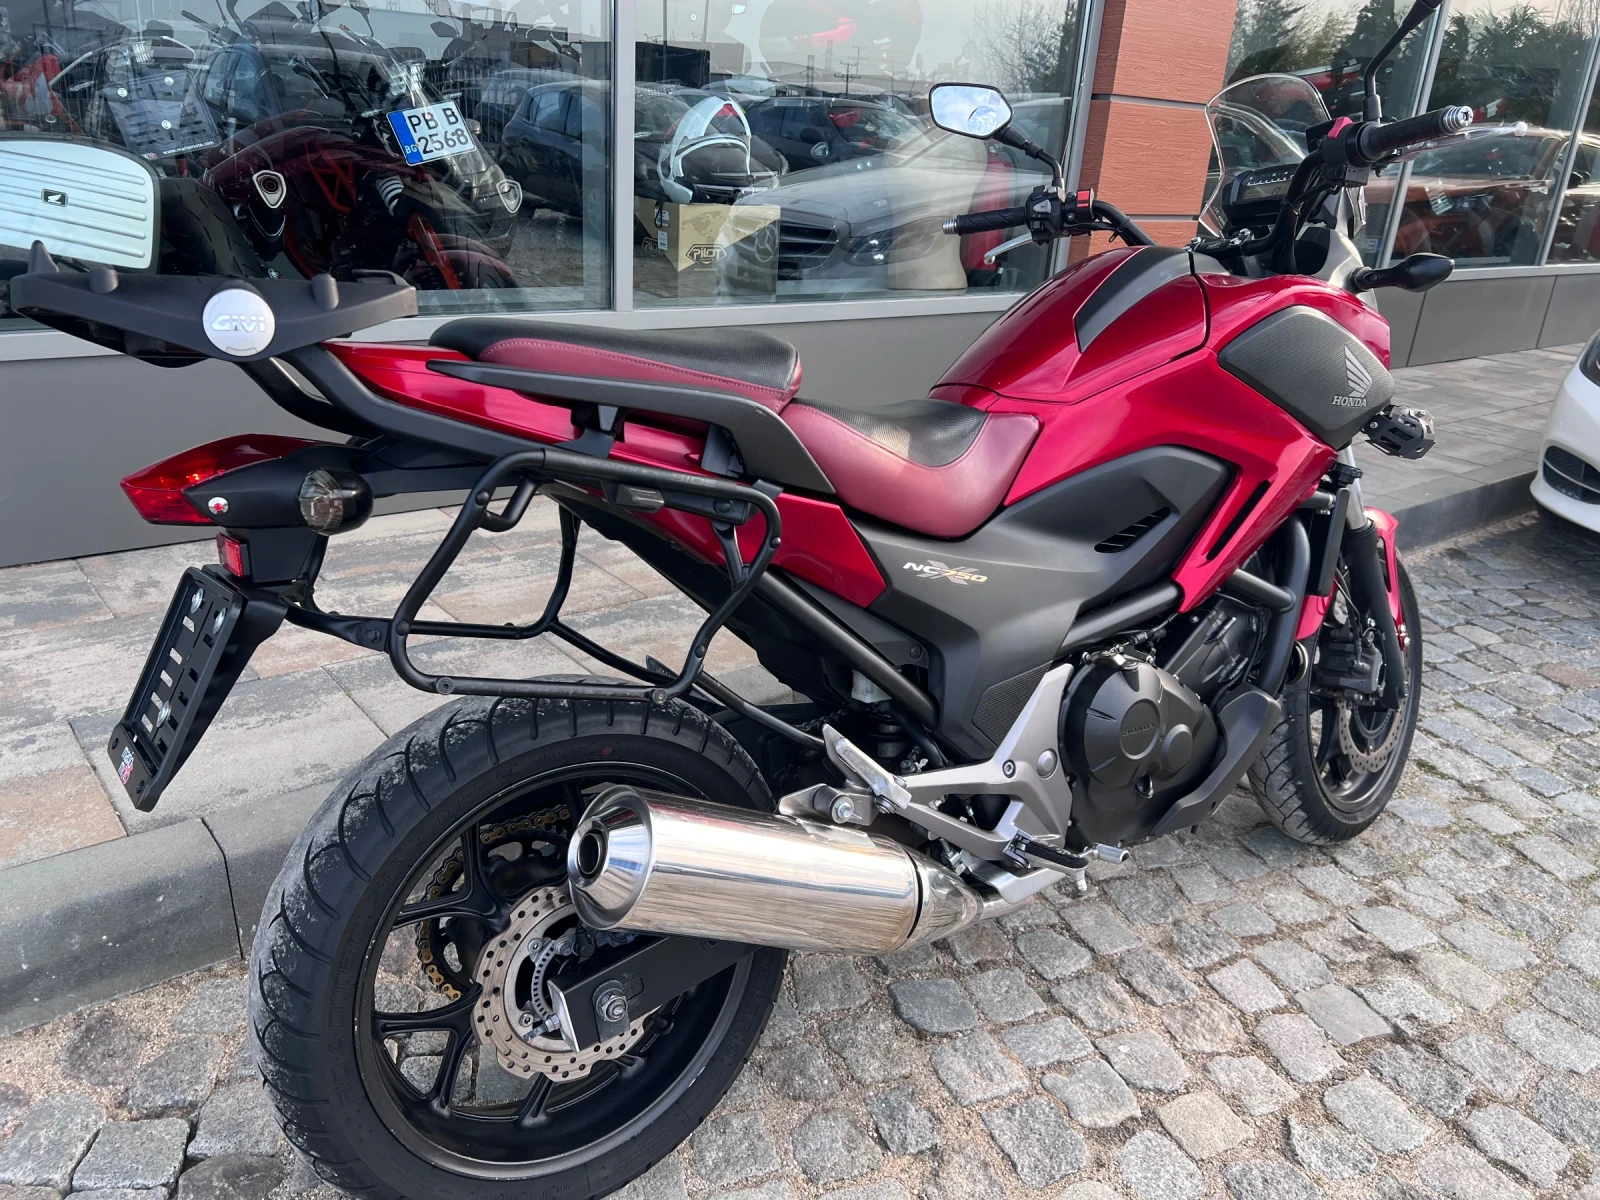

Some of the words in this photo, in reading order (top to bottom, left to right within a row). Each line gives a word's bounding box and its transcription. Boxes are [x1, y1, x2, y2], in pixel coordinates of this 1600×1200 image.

[407, 111, 439, 133] PB
[442, 107, 459, 126] B
[405, 145, 418, 154] BG
[417, 128, 469, 155] 2568
[1331, 395, 1367, 408] HONDA
